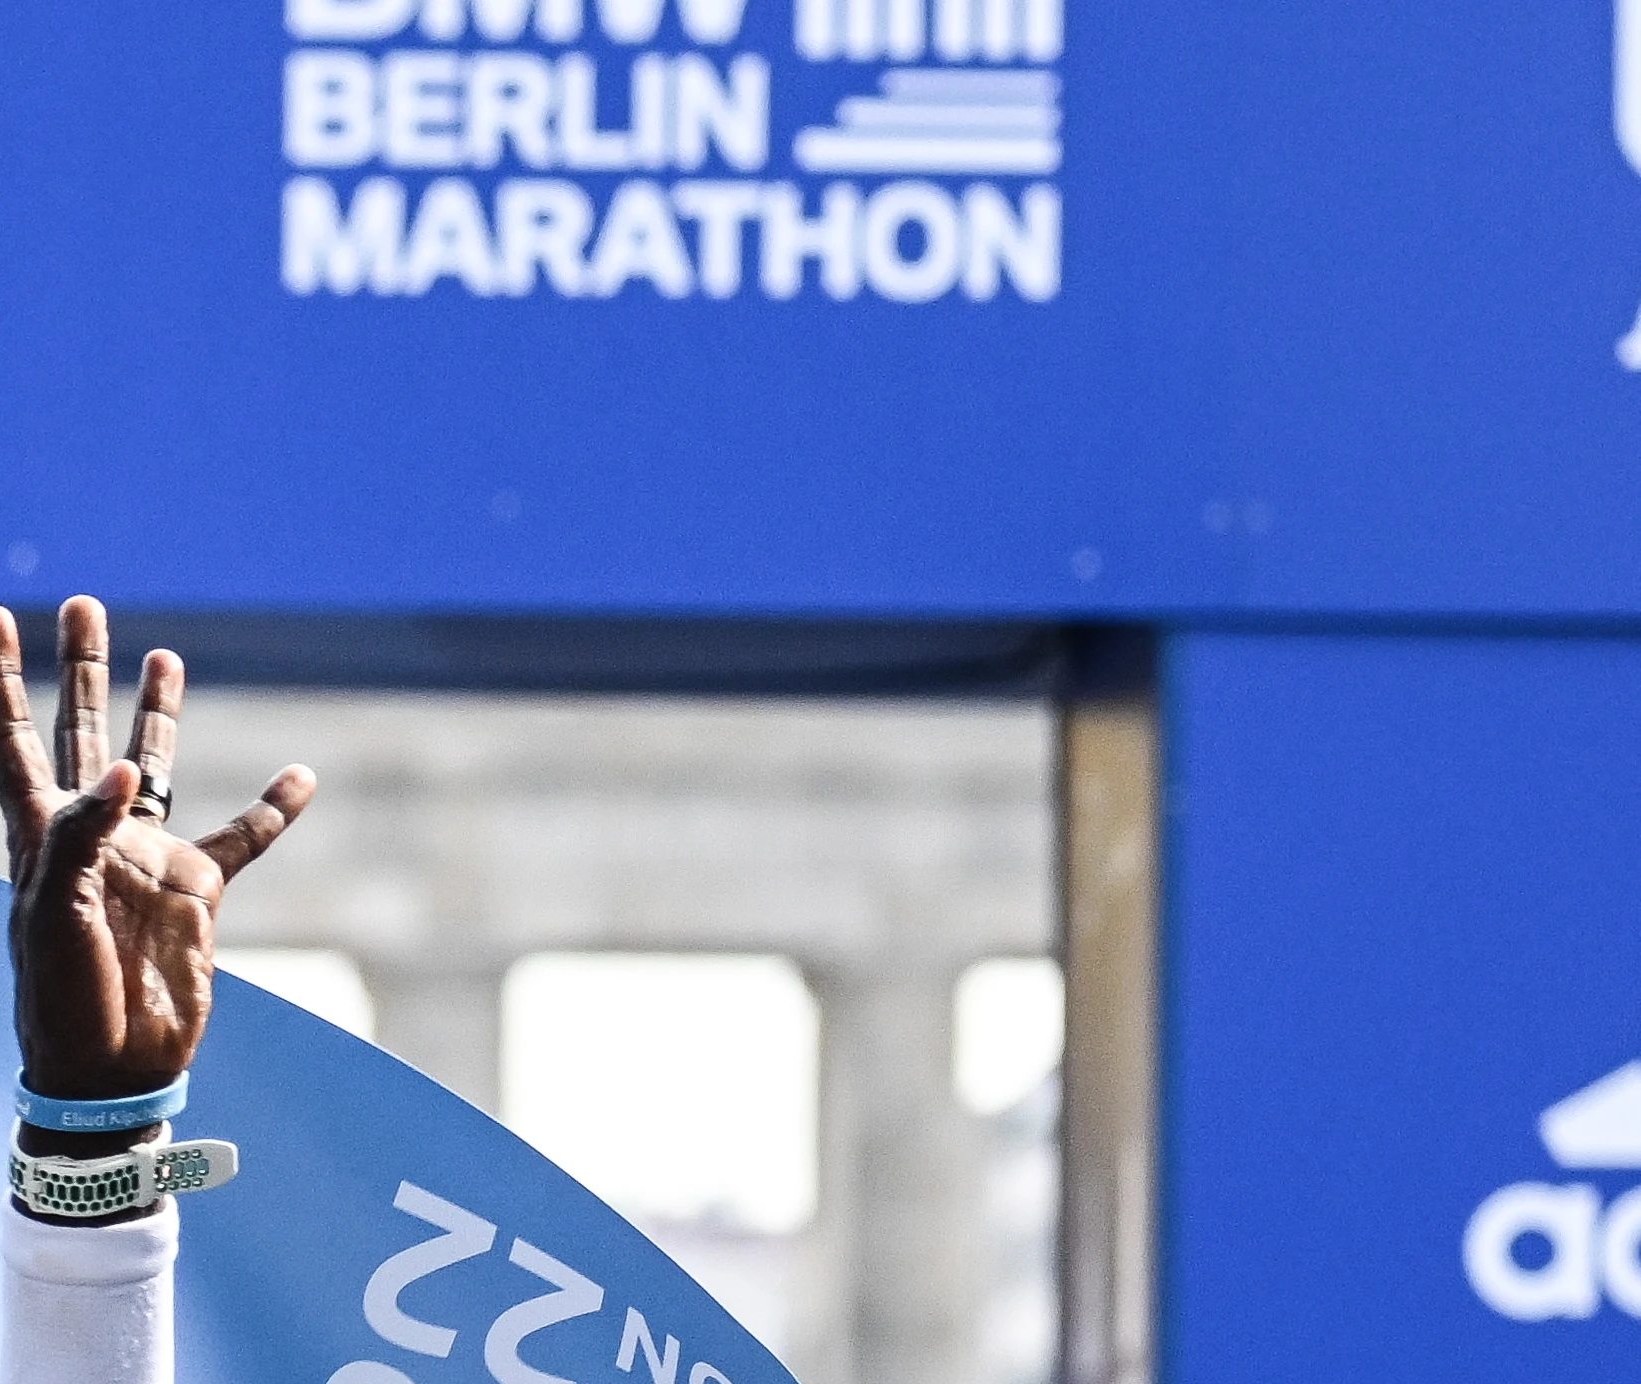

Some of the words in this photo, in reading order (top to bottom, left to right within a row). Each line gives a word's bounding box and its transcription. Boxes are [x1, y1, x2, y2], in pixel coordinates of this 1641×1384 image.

[281, 49, 770, 172] BERLIN
[280, 175, 1063, 304] MARATHON
[1463, 1182, 1641, 1322] a
